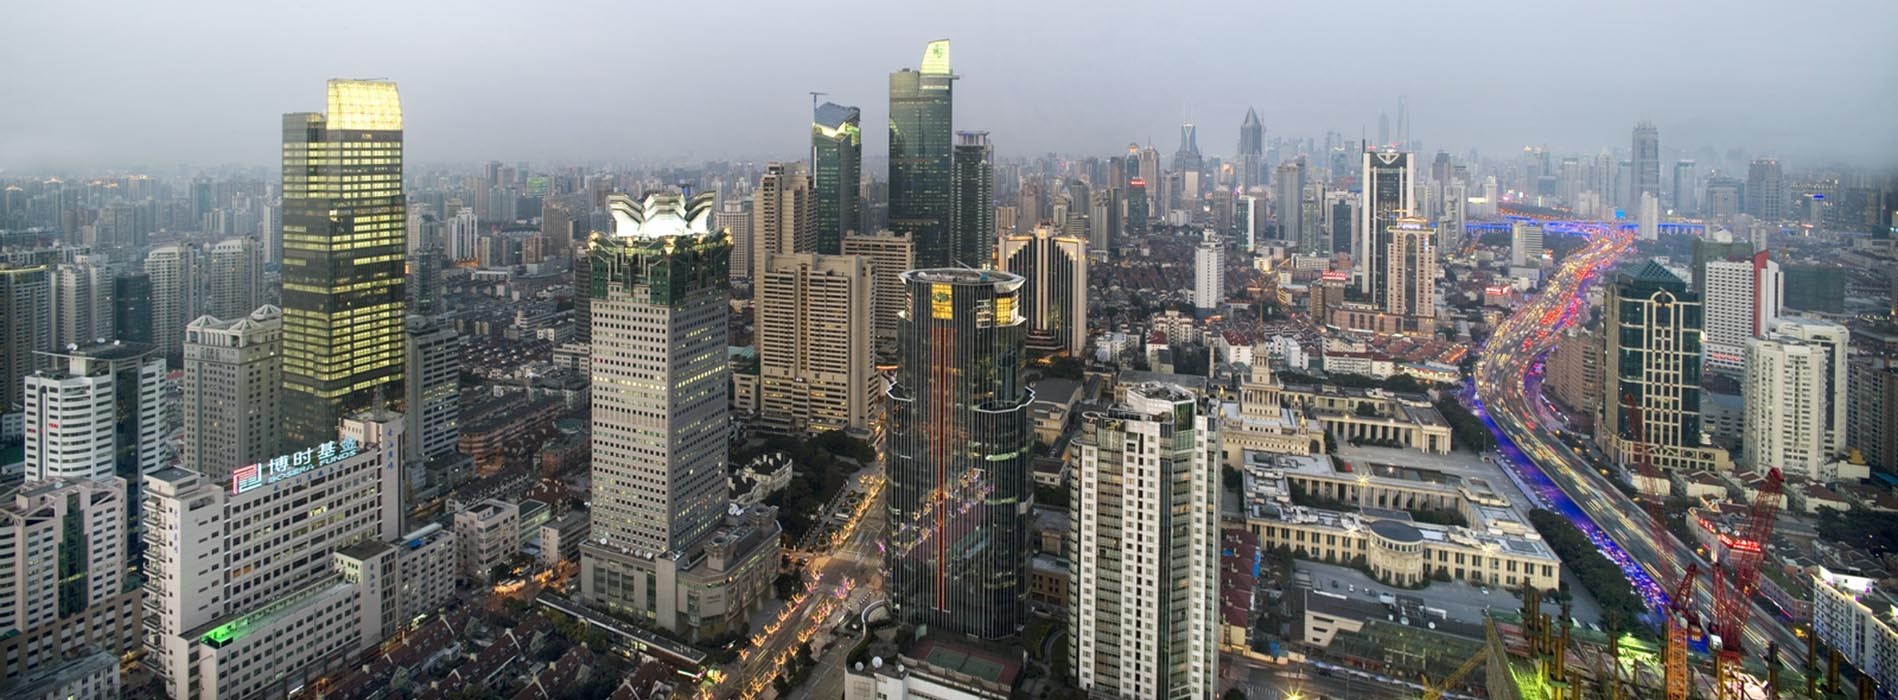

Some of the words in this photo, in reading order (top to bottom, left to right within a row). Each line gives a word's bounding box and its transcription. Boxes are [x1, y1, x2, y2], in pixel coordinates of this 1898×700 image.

[268, 436, 357, 475] 博时基金
[268, 464, 314, 483] BOSERA
[319, 449, 357, 466] FUNDS
